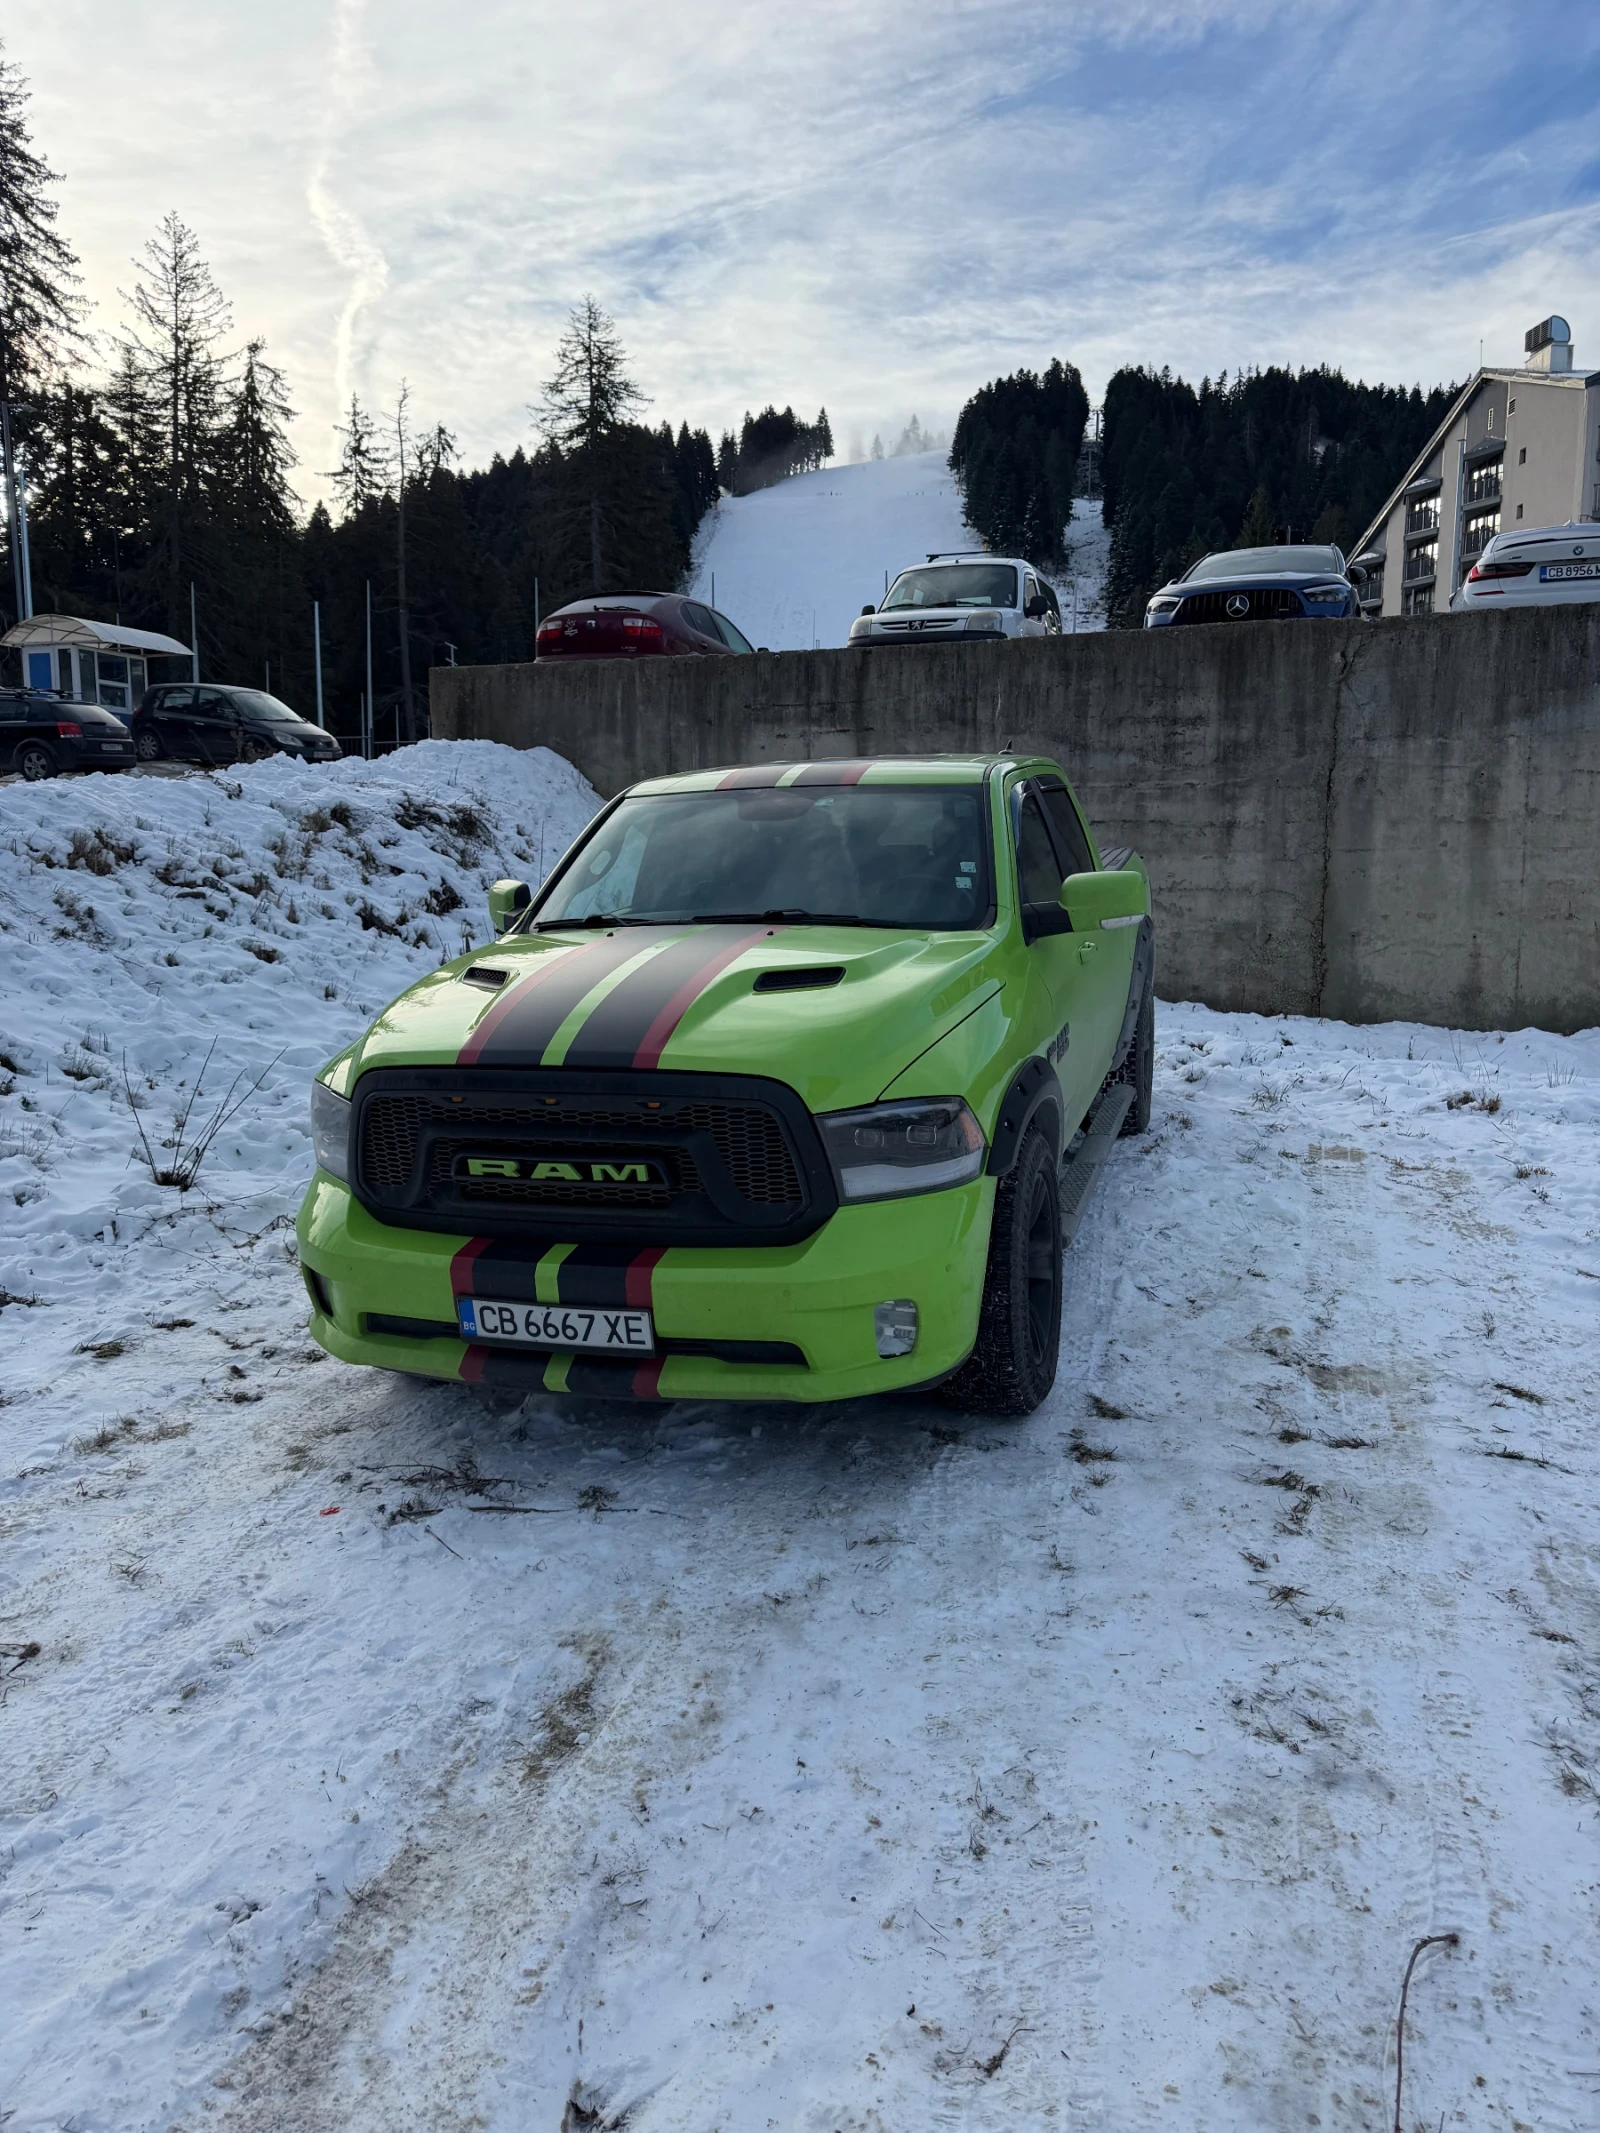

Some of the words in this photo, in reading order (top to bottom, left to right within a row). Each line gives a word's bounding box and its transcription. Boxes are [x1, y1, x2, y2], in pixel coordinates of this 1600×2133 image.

[1548, 567, 1563, 578] CB
[1566, 565, 1593, 576] 8956
[467, 1159, 649, 1182] RAM
[463, 1321, 475, 1331] BG
[479, 1305, 517, 1335] CB
[525, 1310, 595, 1342] 6667
[603, 1315, 646, 1345] XE
